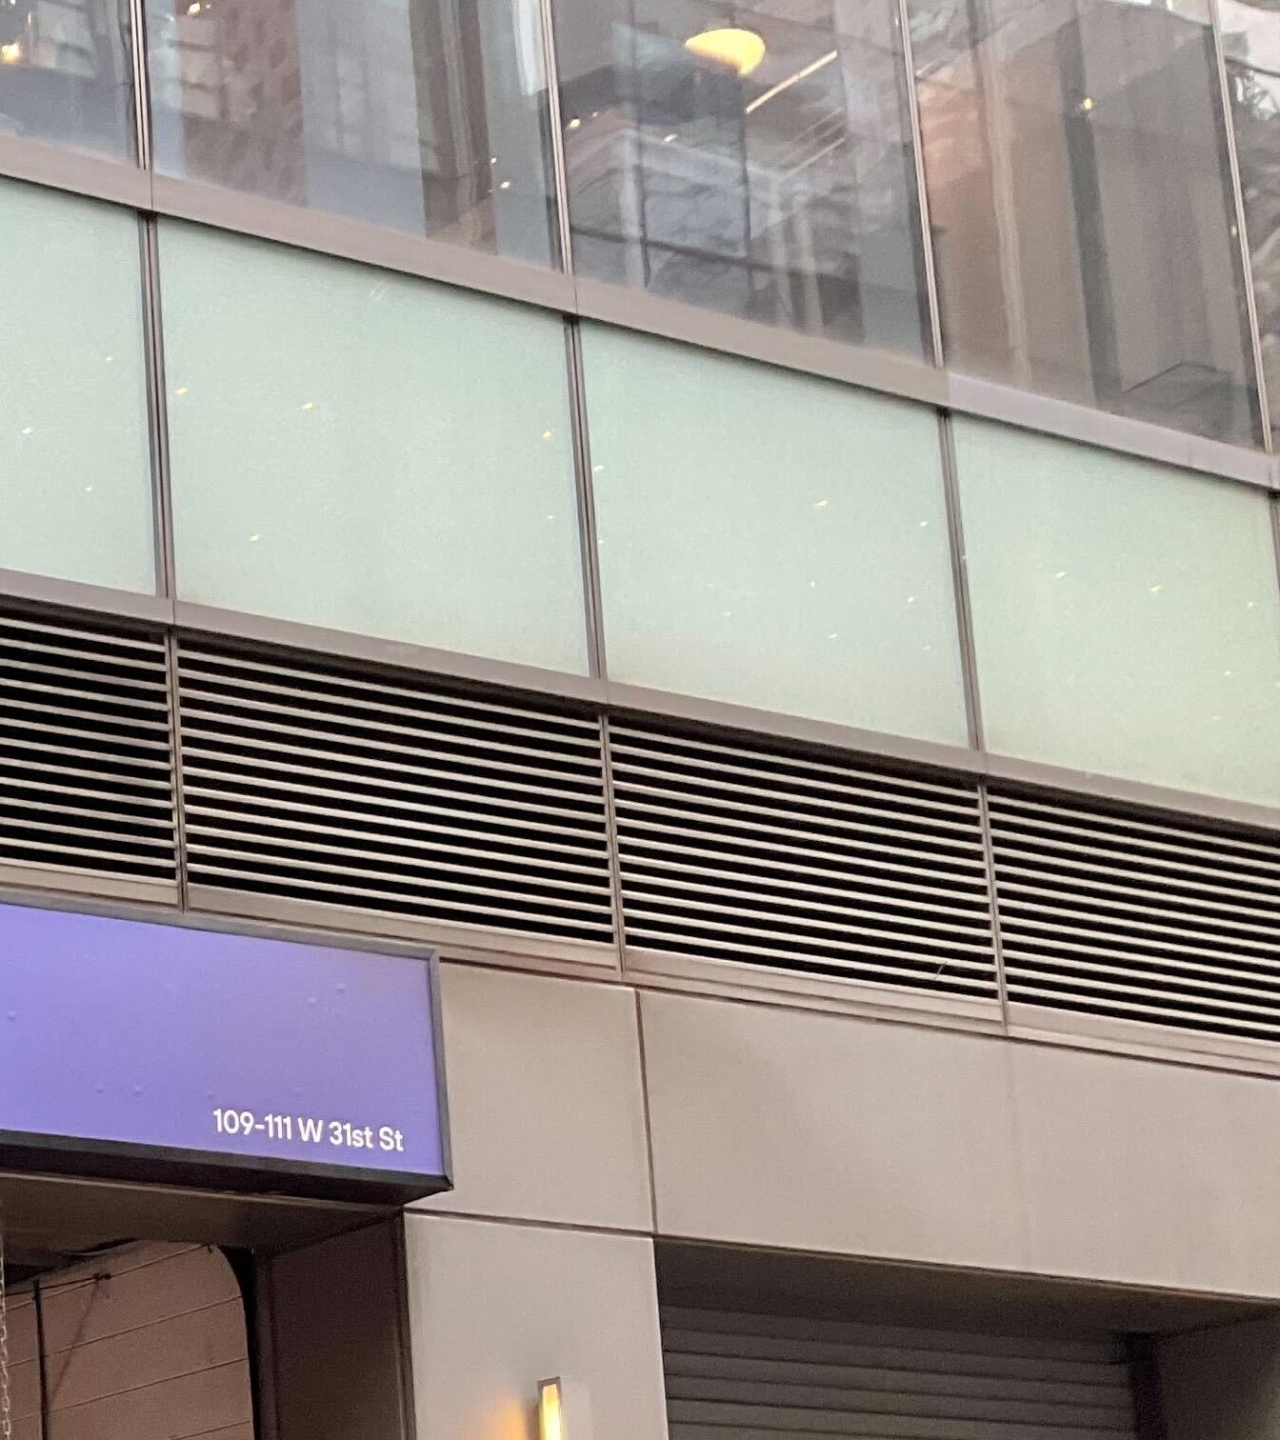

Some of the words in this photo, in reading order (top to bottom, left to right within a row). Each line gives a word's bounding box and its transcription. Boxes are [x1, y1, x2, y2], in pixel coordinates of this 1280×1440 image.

[213, 1108, 292, 1141] 109-111
[298, 1116, 323, 1143] W
[329, 1121, 373, 1149] 31st
[379, 1126, 404, 1152] St
